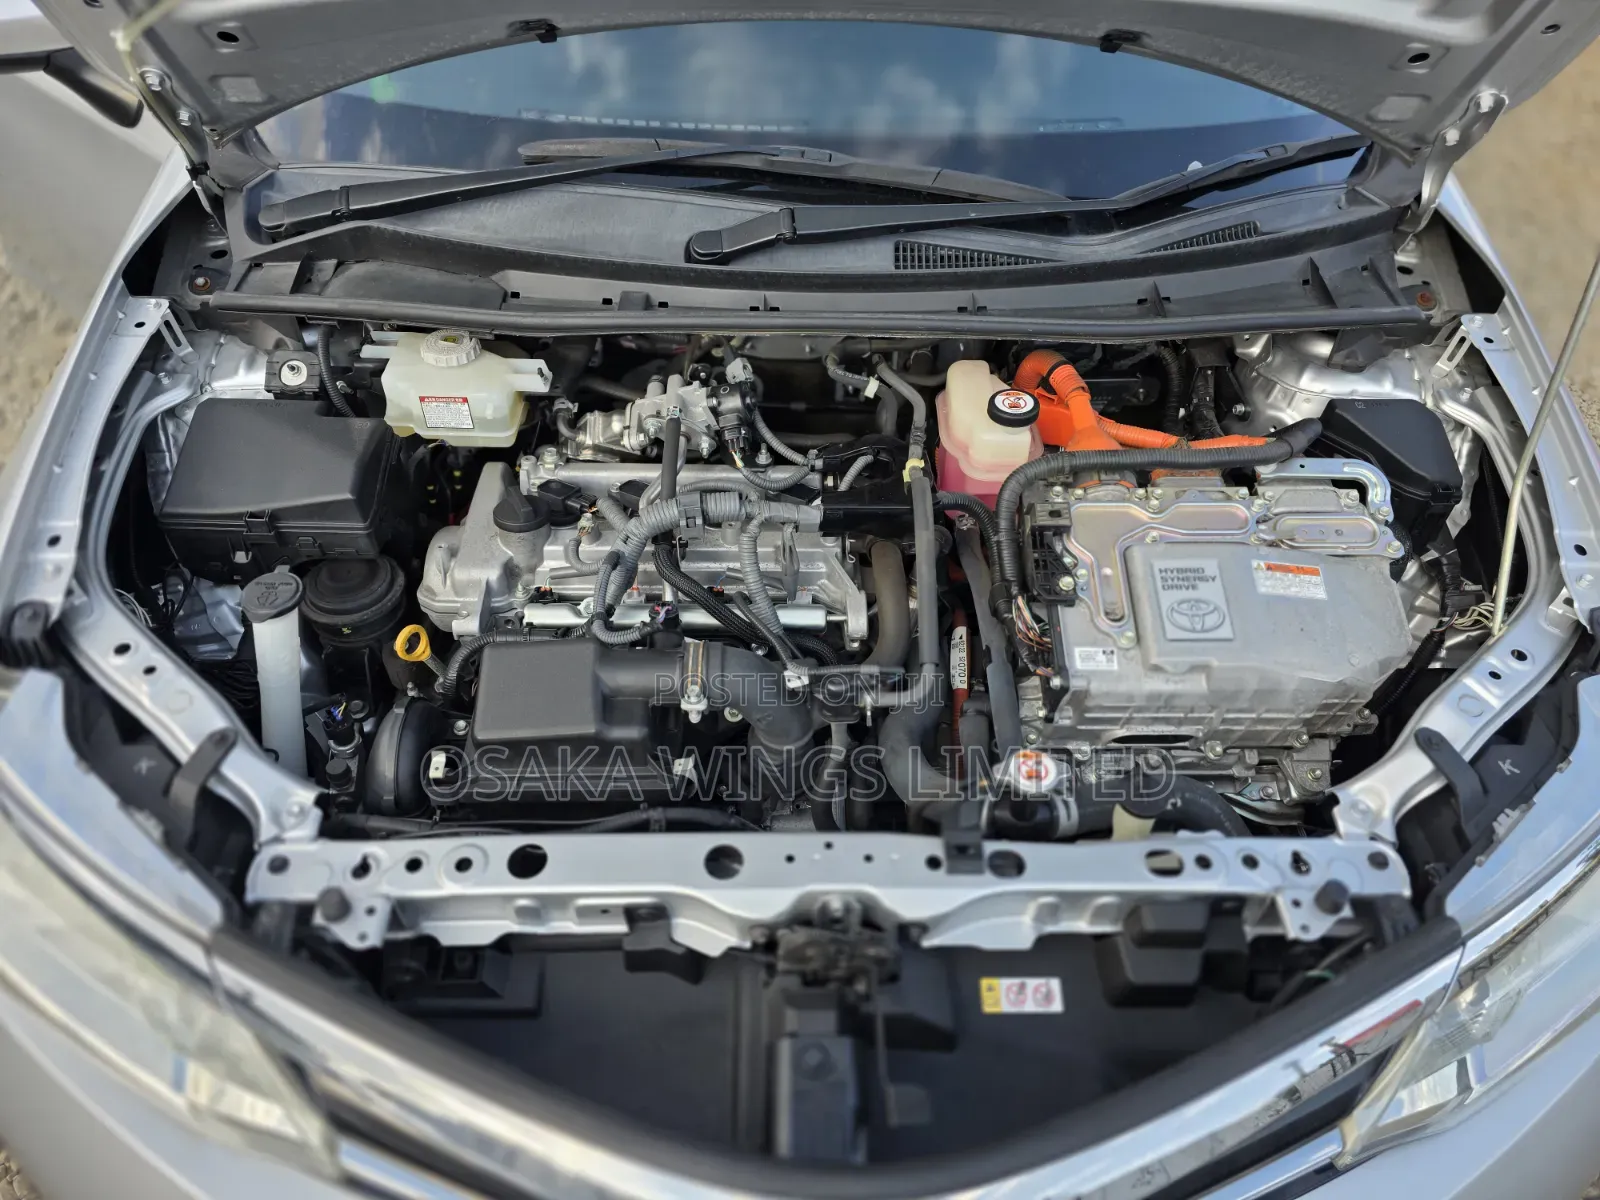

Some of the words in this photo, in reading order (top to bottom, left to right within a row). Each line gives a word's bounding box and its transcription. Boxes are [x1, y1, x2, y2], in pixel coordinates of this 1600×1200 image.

[1159, 567, 1205, 575] HYBRID
[1160, 575, 1217, 583] SYNERGY
[1162, 583, 1199, 591] DRIVE
